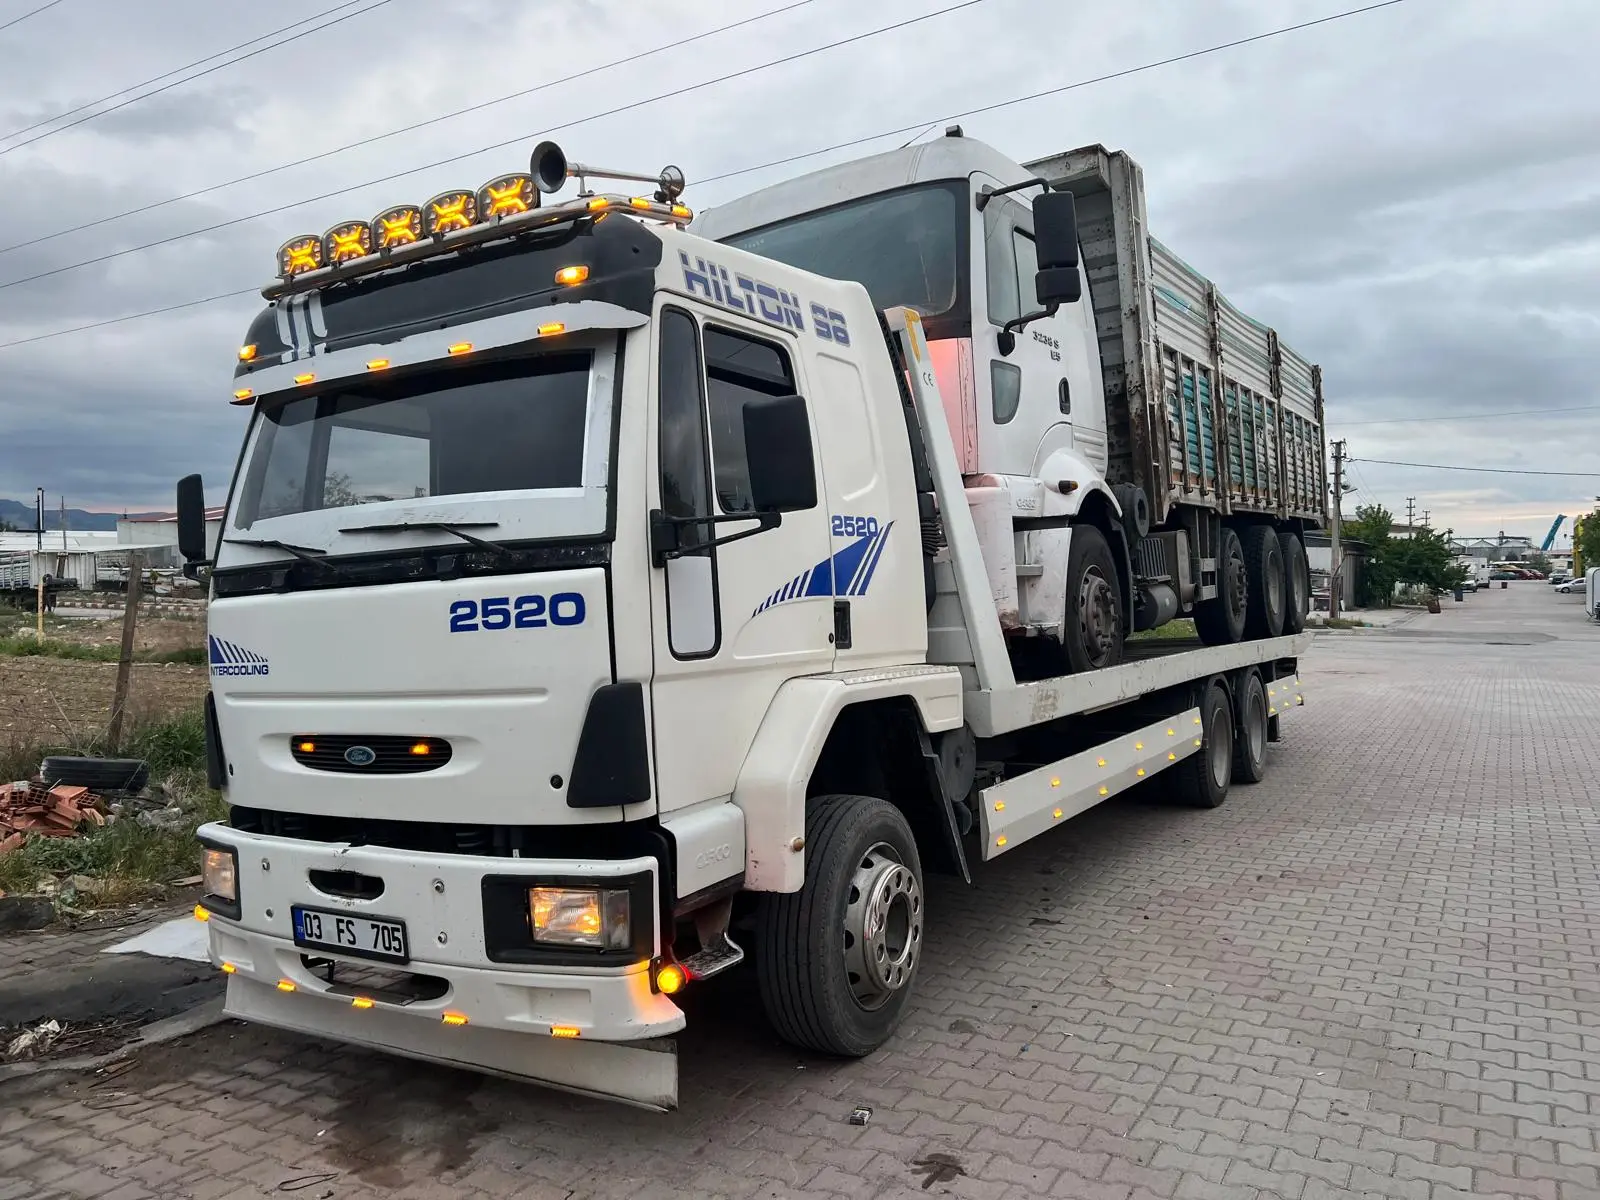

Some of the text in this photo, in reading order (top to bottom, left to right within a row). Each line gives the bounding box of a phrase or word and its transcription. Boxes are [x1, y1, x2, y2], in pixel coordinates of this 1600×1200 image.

[678, 249, 805, 332] HILTON
[831, 514, 879, 538] 2520
[449, 592, 586, 633] 2520
[210, 664, 269, 676] NTERCOOLING
[303, 912, 403, 954] 03 FS 705
